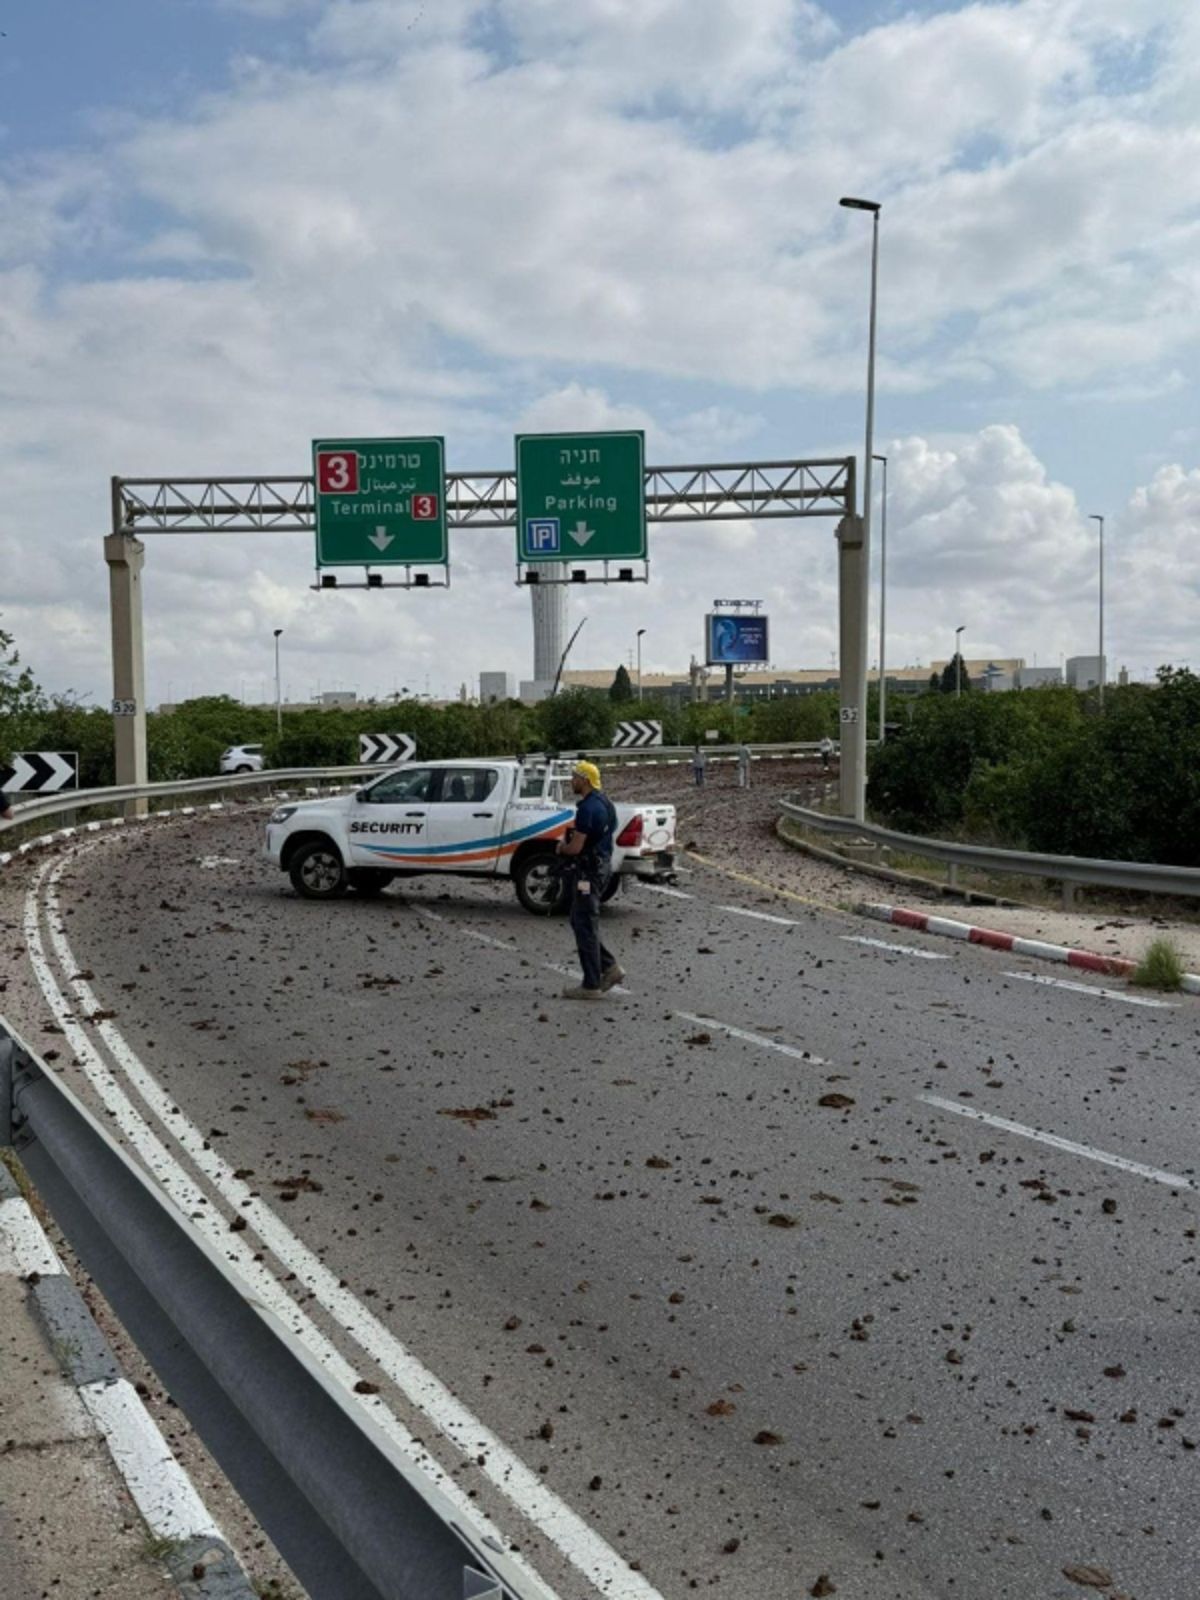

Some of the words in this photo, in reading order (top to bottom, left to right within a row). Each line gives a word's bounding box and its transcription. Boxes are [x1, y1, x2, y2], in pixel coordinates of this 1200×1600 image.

[560, 449, 600, 464] חניה
[327, 456, 350, 489] 3
[560, 472, 601, 490] موقف
[331, 499, 410, 515] Terminal
[418, 497, 432, 517] 3
[545, 495, 617, 512] Parking
[349, 821, 424, 835] SECURITY
